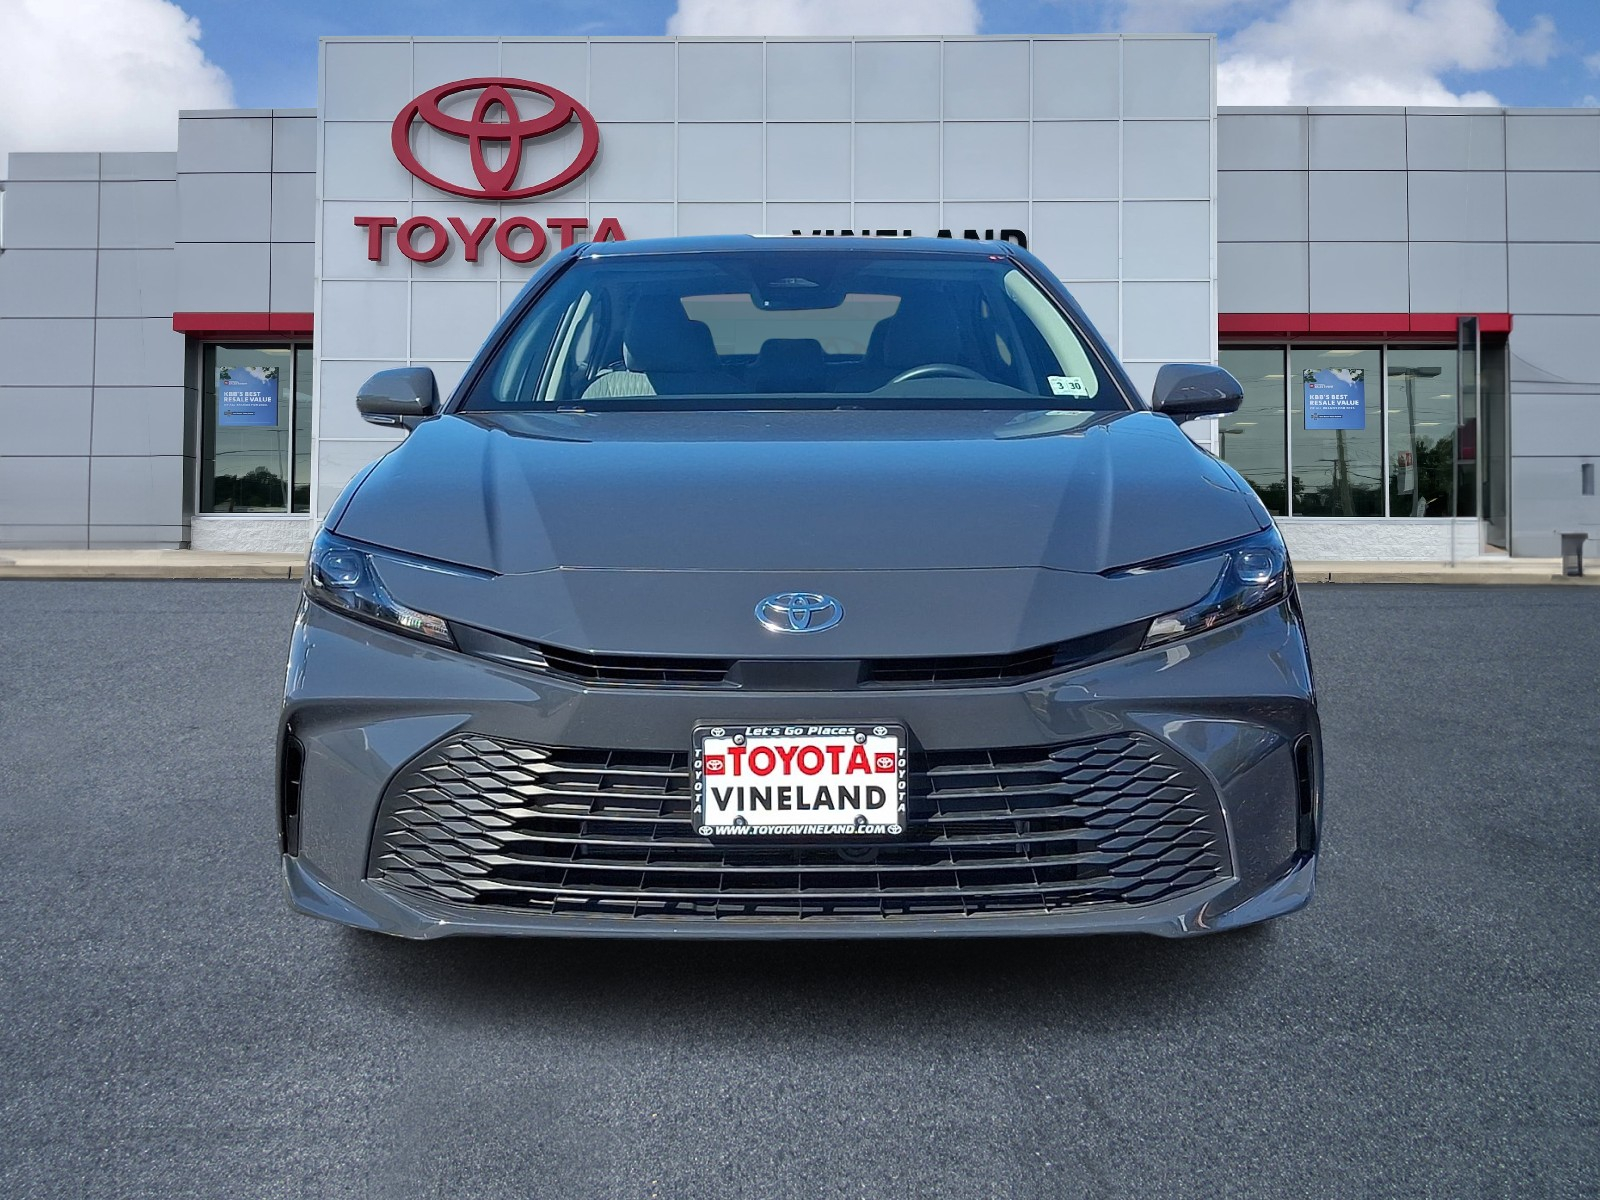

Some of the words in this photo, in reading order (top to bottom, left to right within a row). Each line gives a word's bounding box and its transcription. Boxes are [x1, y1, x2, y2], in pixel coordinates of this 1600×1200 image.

[745, 727, 780, 736] Let's
[784, 727, 804, 736] Go
[807, 726, 856, 735] Places
[727, 745, 873, 777] TOYOTA
[694, 749, 703, 813] TOYOTA
[898, 747, 906, 812] TOYOTA
[711, 785, 887, 812] VINELAND
[715, 824, 886, 835] WWW.TOYOTAVINELAND.COM
